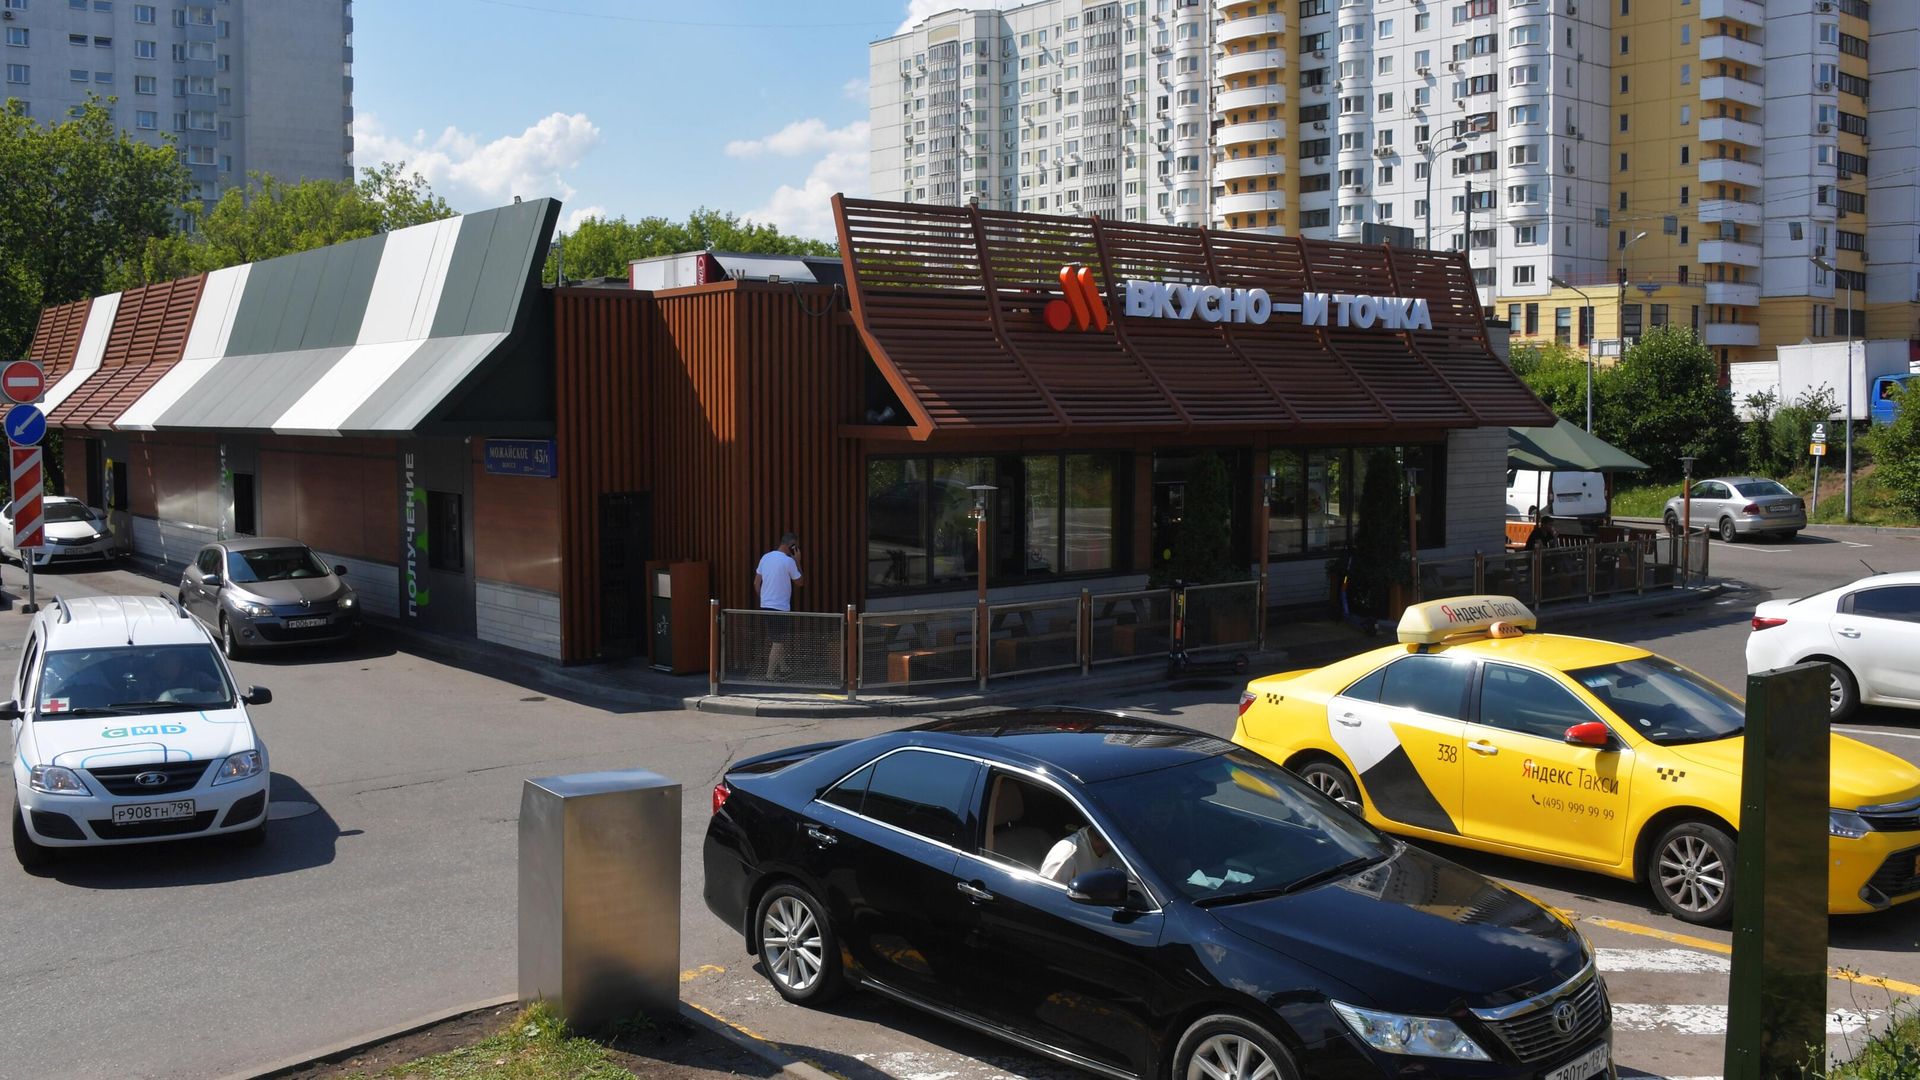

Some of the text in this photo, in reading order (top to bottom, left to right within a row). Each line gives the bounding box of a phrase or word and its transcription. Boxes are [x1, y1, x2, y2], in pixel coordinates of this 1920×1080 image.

[1332, 293, 1433, 330] ТОЧКА
[1816, 423, 1823, 433] 2
[489, 445, 529, 460] МОЖАЙСКОЕ
[405, 452, 417, 618] ПОЛУЧЕНИЕ
[1440, 600, 1522, 624] Яндекс Такси
[101, 724, 187, 739] CMD
[1437, 743, 1458, 764] 338
[1521, 758, 1619, 795] Яндекс Такси
[118, 802, 191, 820] Р908ТН 799
[1542, 796, 1615, 821] (495) 999 99 99
